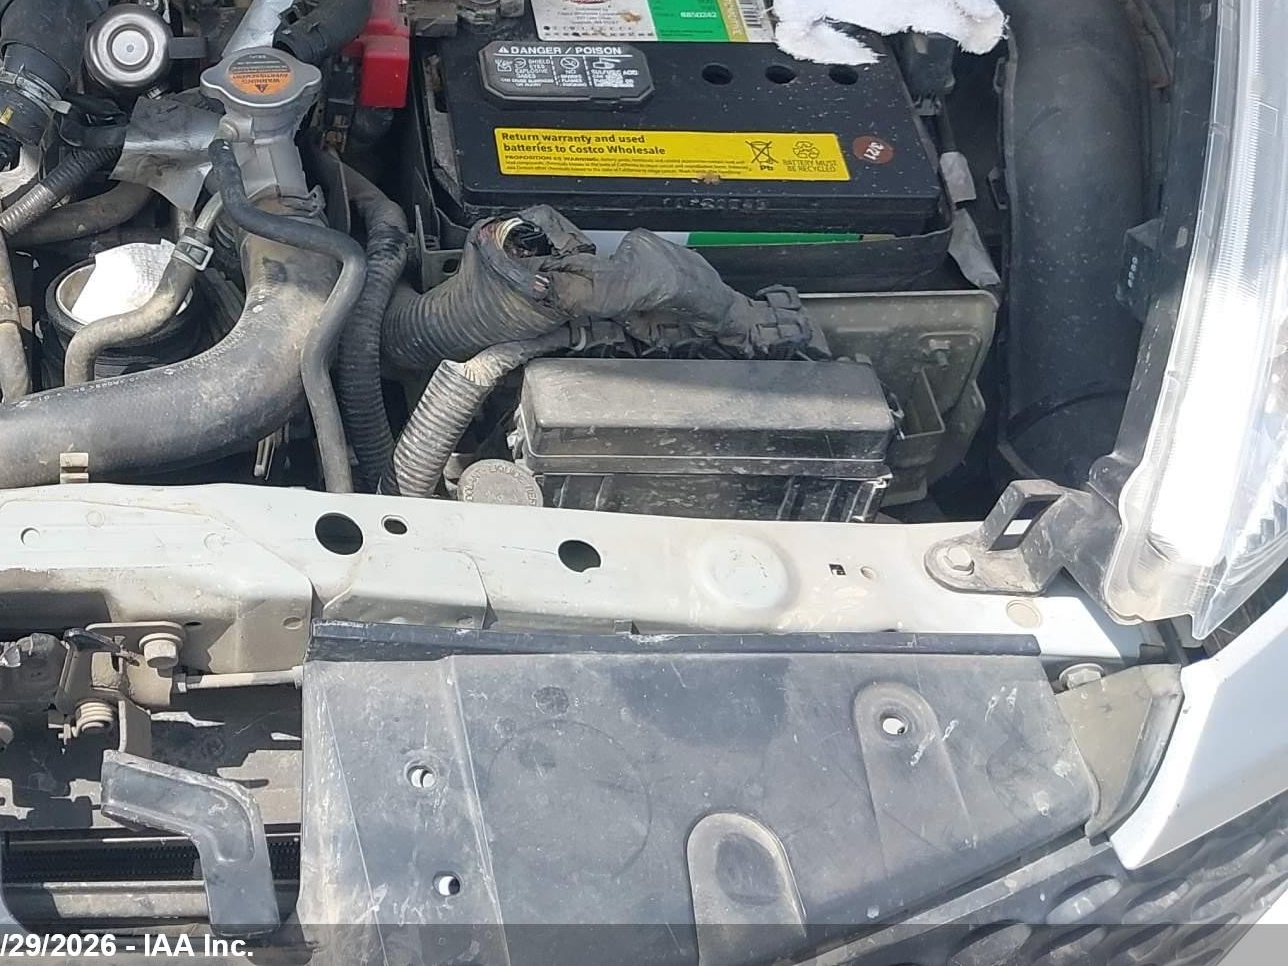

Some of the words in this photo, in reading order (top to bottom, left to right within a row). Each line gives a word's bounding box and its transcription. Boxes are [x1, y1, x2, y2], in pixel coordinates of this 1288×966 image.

[502, 132, 539, 141] Return
[539, 134, 592, 144] warranty
[595, 134, 616, 143] and
[618, 134, 645, 143] used
[503, 143, 553, 152] batteries
[555, 144, 566, 153] to
[568, 145, 605, 154] Costco
[606, 145, 666, 155] Wholesale
